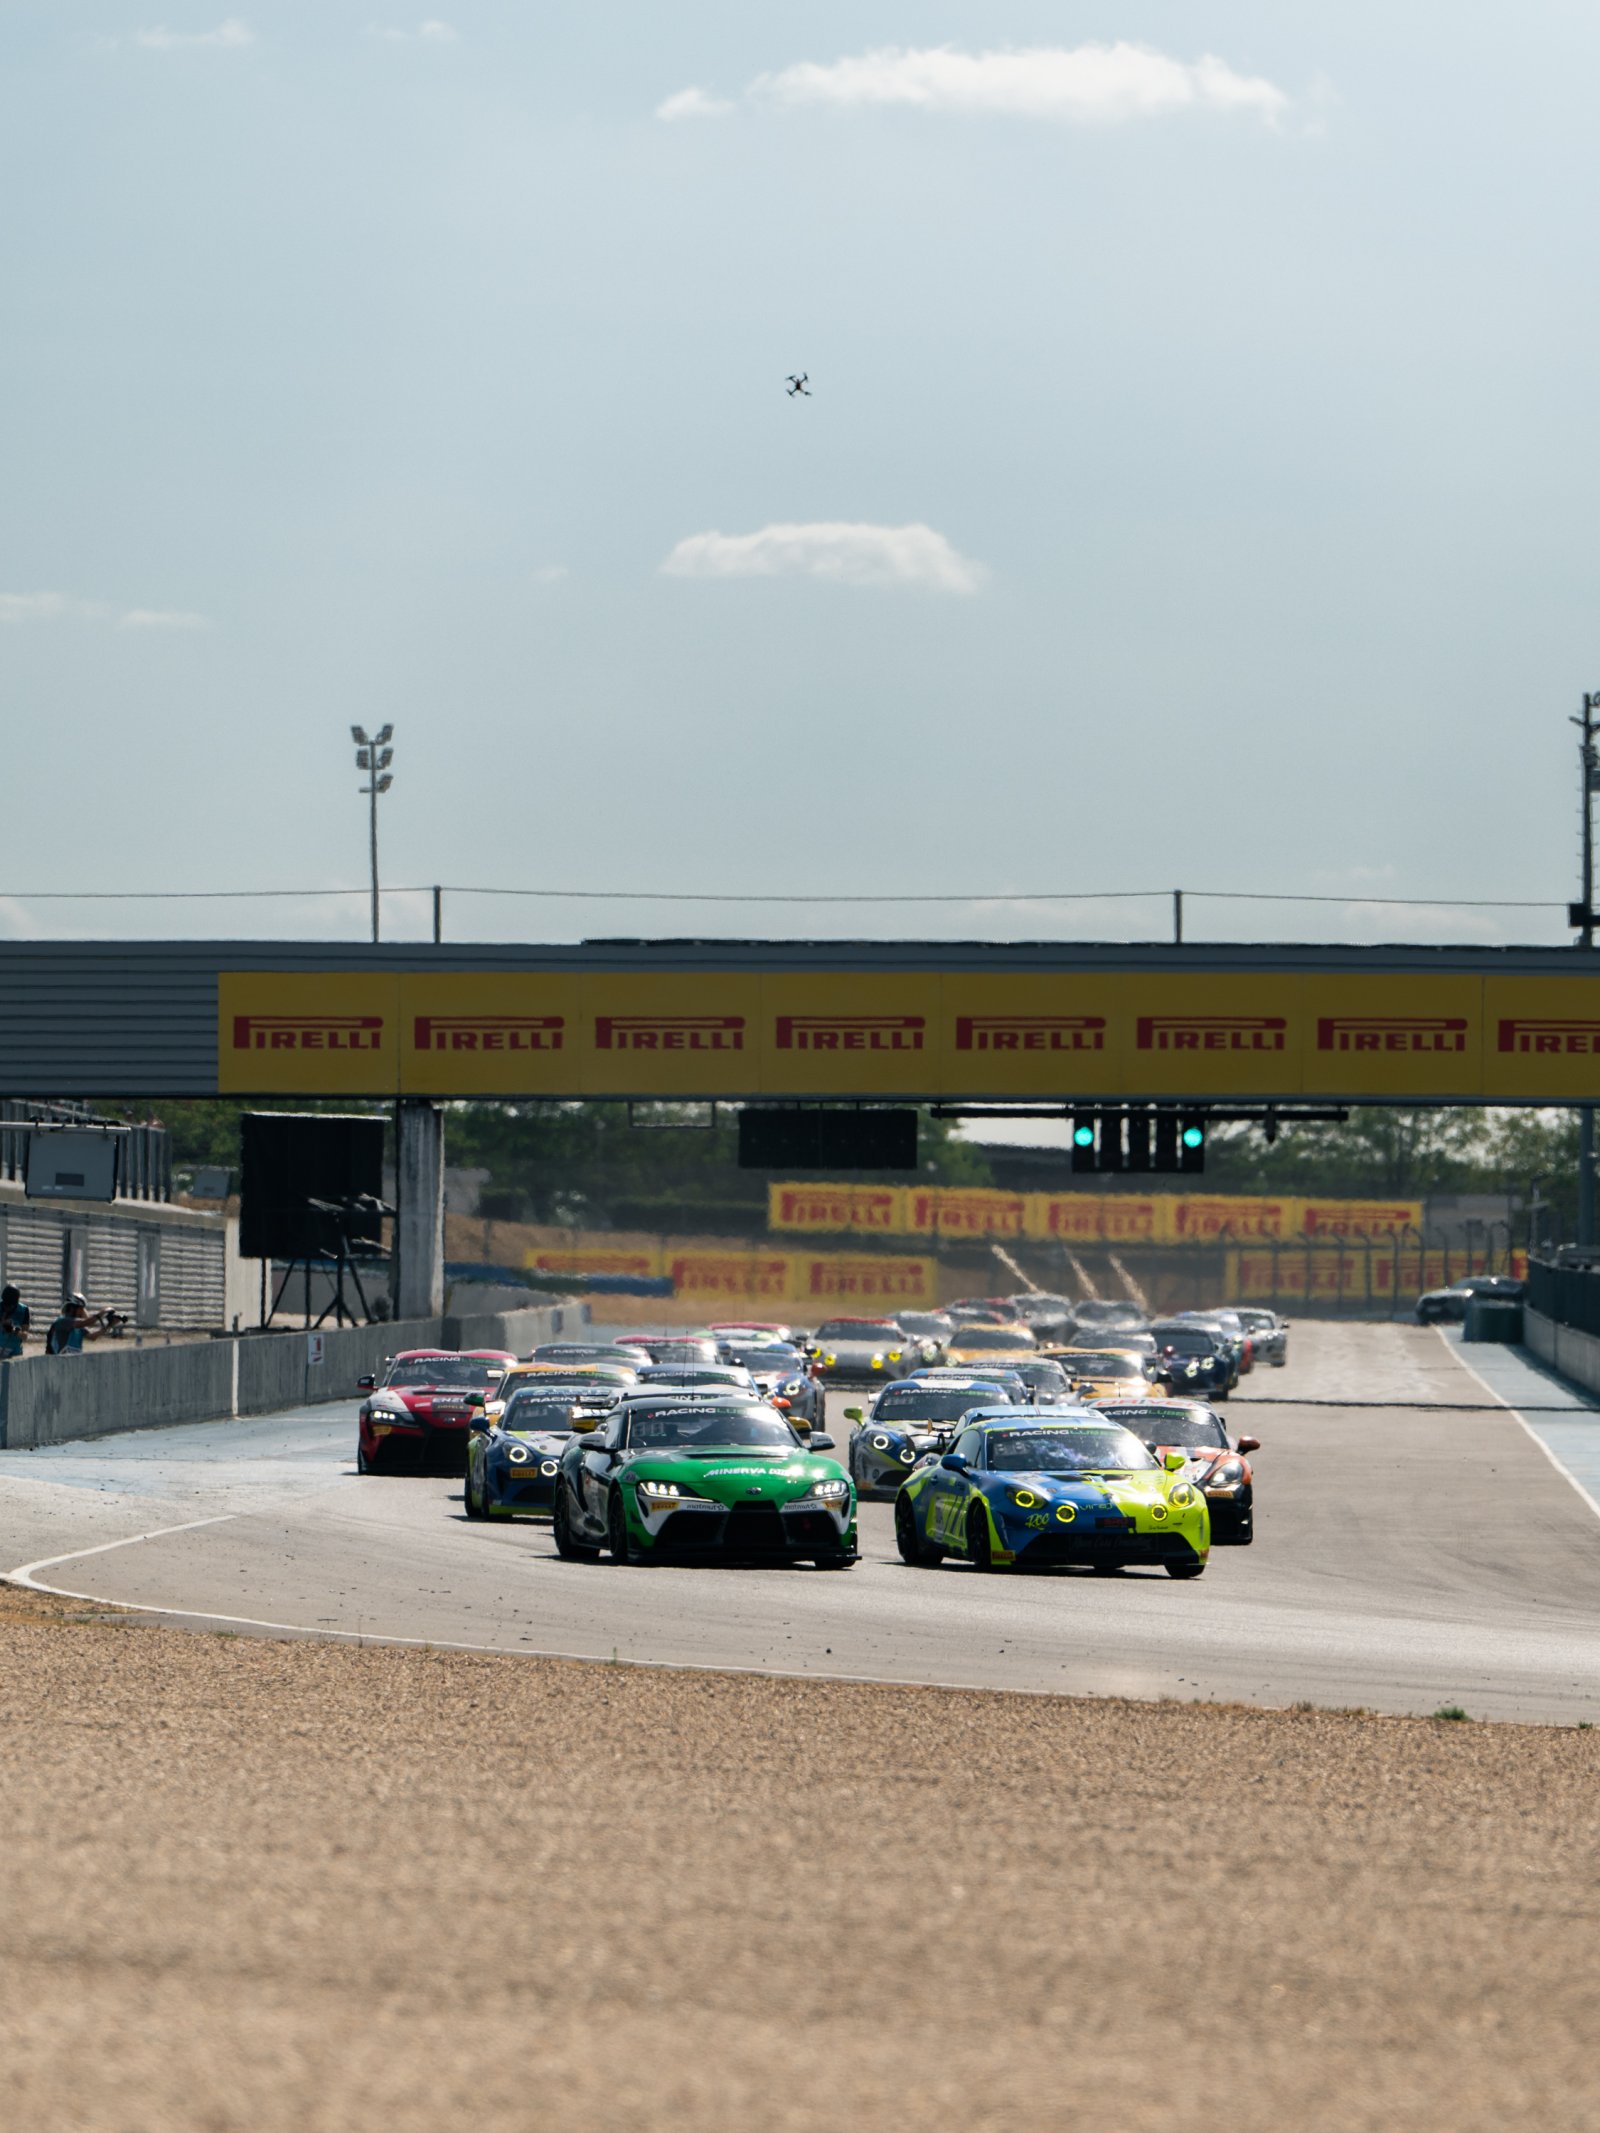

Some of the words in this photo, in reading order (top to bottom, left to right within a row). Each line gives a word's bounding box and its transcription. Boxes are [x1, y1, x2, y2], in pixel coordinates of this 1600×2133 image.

[234, 1016, 383, 1049] PIRELLI
[415, 1016, 565, 1050] PIRELLI
[596, 1016, 745, 1049] PIRELLI
[776, 1016, 924, 1050] PIRELLI
[956, 1016, 1105, 1049] PIRELLI
[1136, 1017, 1287, 1050] PIRELLI
[1318, 1017, 1466, 1051] PIRELLI
[780, 1192, 893, 1227] PIRELLI
[1175, 1203, 1281, 1236] PIRELLI
[703, 1468, 767, 1477] MINERVA
